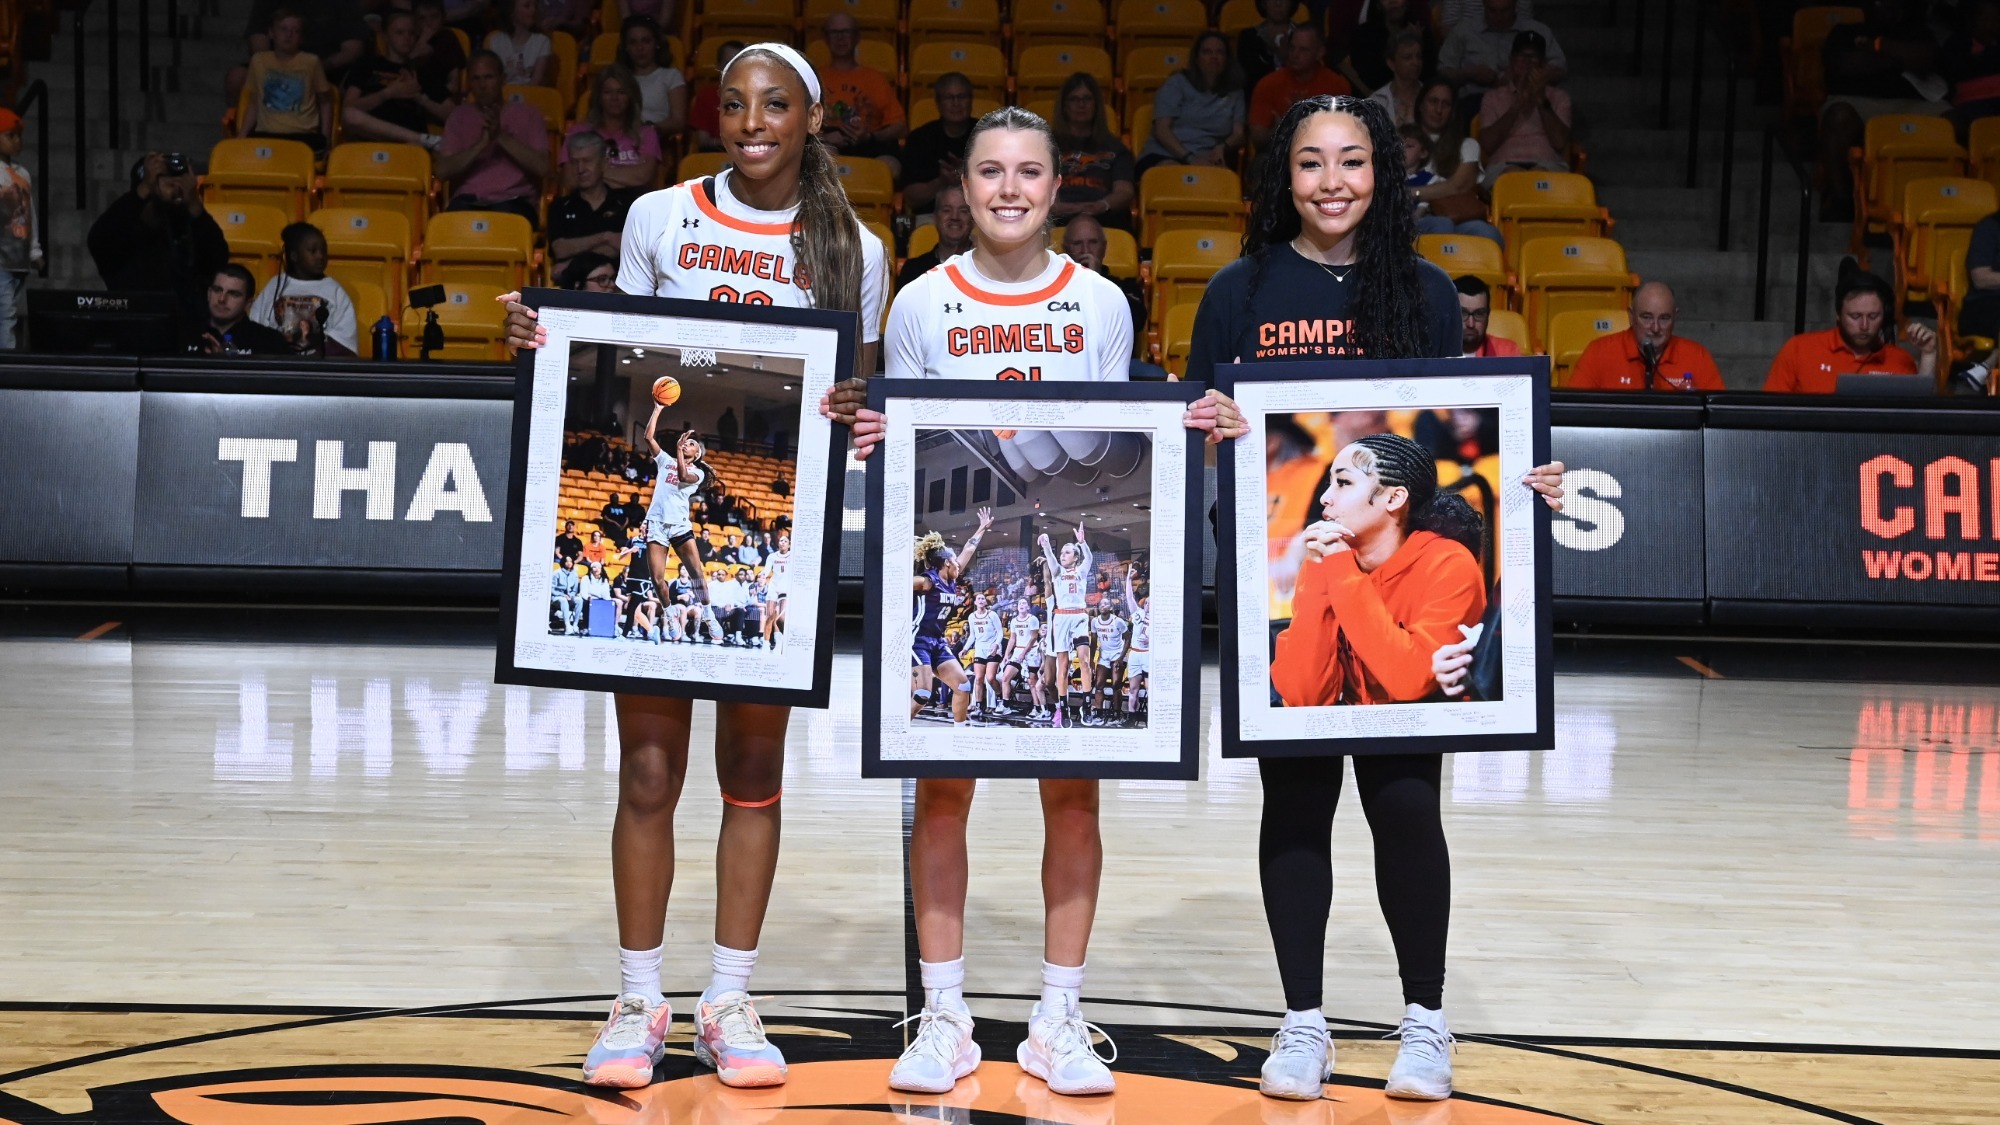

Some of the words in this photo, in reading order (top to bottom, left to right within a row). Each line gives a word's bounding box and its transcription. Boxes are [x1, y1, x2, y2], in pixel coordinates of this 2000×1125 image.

[678, 243, 813, 290] CAMELS
[1047, 301, 1081, 312] CAA
[948, 323, 1084, 357] CAMELS
[1256, 346, 1323, 358] WOMEN'S
[1327, 346, 1366, 356] BAK
[1860, 454, 2000, 540] CA
[1862, 550, 2000, 581] WOME
[1069, 583, 1077, 593] 21
